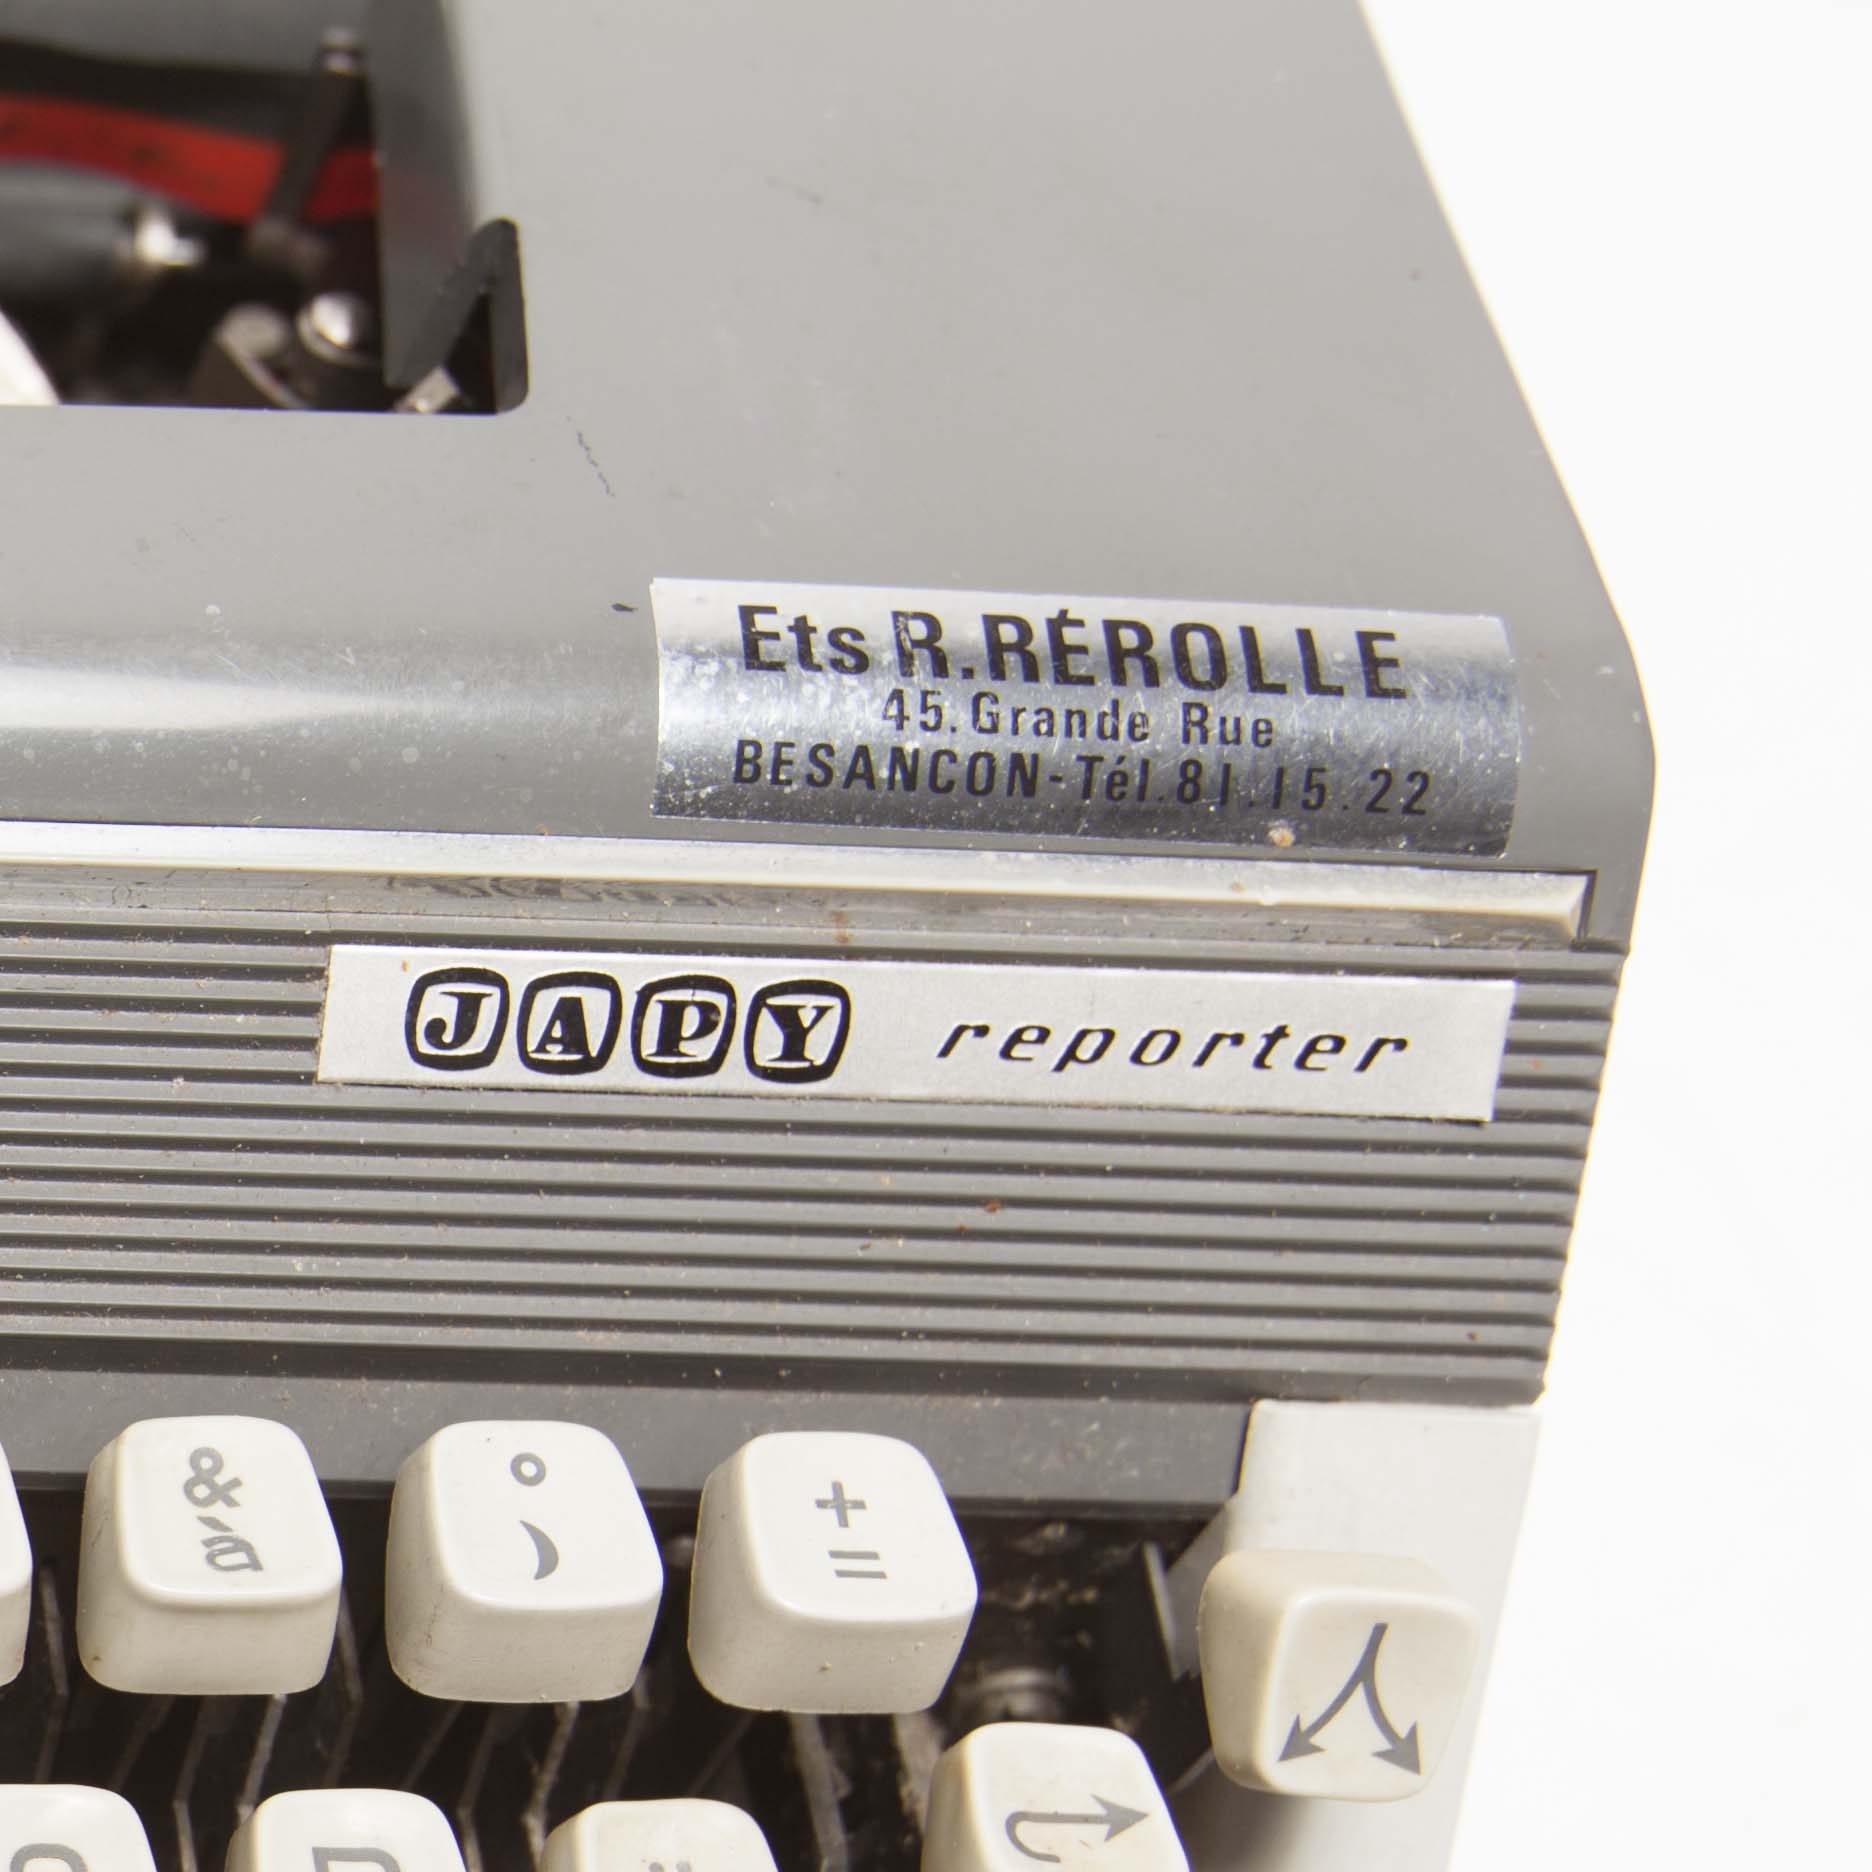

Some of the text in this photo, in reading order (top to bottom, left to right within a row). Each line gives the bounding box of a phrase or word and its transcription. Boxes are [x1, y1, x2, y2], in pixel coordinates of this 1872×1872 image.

[737, 604, 870, 675] Ets
[1181, 701, 1274, 748] Rue
[419, 986, 1412, 1075] JAPY reporter
[181, 1445, 244, 1510] &
